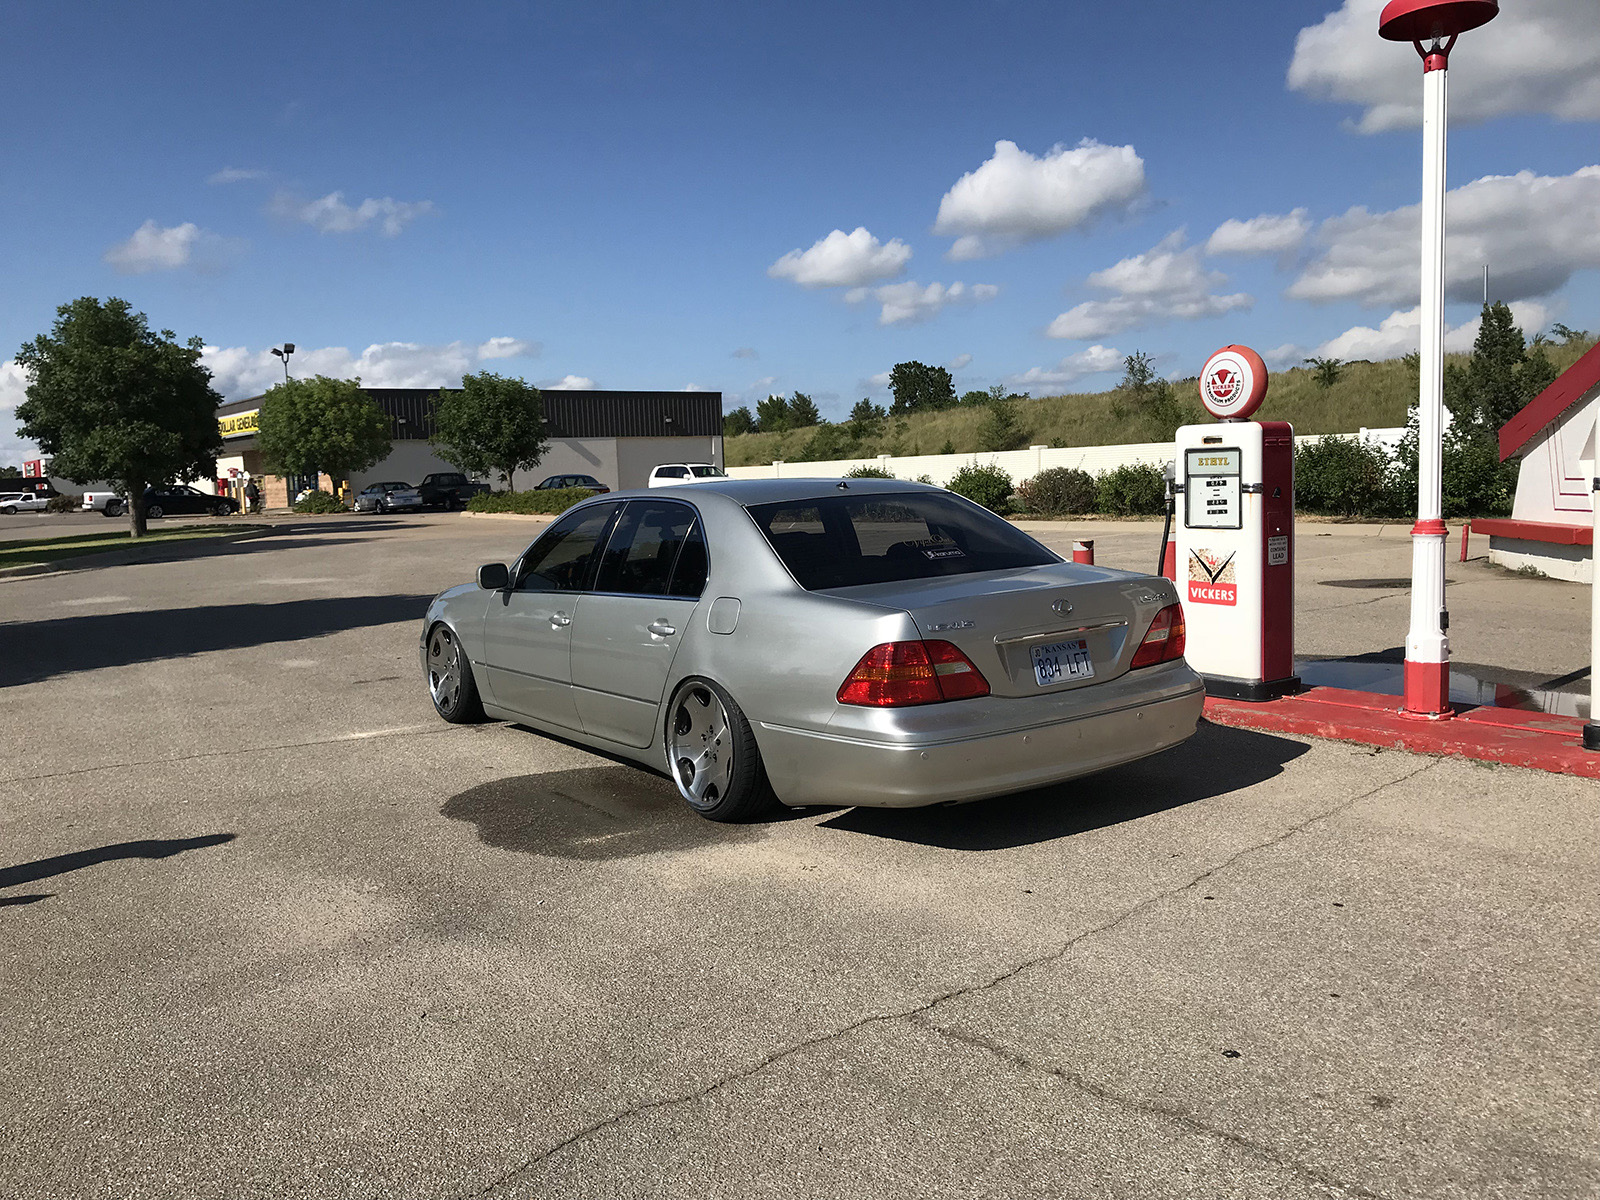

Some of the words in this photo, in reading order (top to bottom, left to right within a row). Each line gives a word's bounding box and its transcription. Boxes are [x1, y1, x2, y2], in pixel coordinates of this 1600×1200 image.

[1206, 381, 1224, 403] PETROLEUM
[1224, 379, 1241, 403] PRODUCTS
[1198, 457, 1230, 466] ETHYL
[1272, 552, 1285, 560] LEAD
[1190, 586, 1235, 602] VICKERS
[1044, 642, 1077, 654] KANSAS
[1037, 656, 1062, 679] 834
[1066, 651, 1089, 674] LFT
